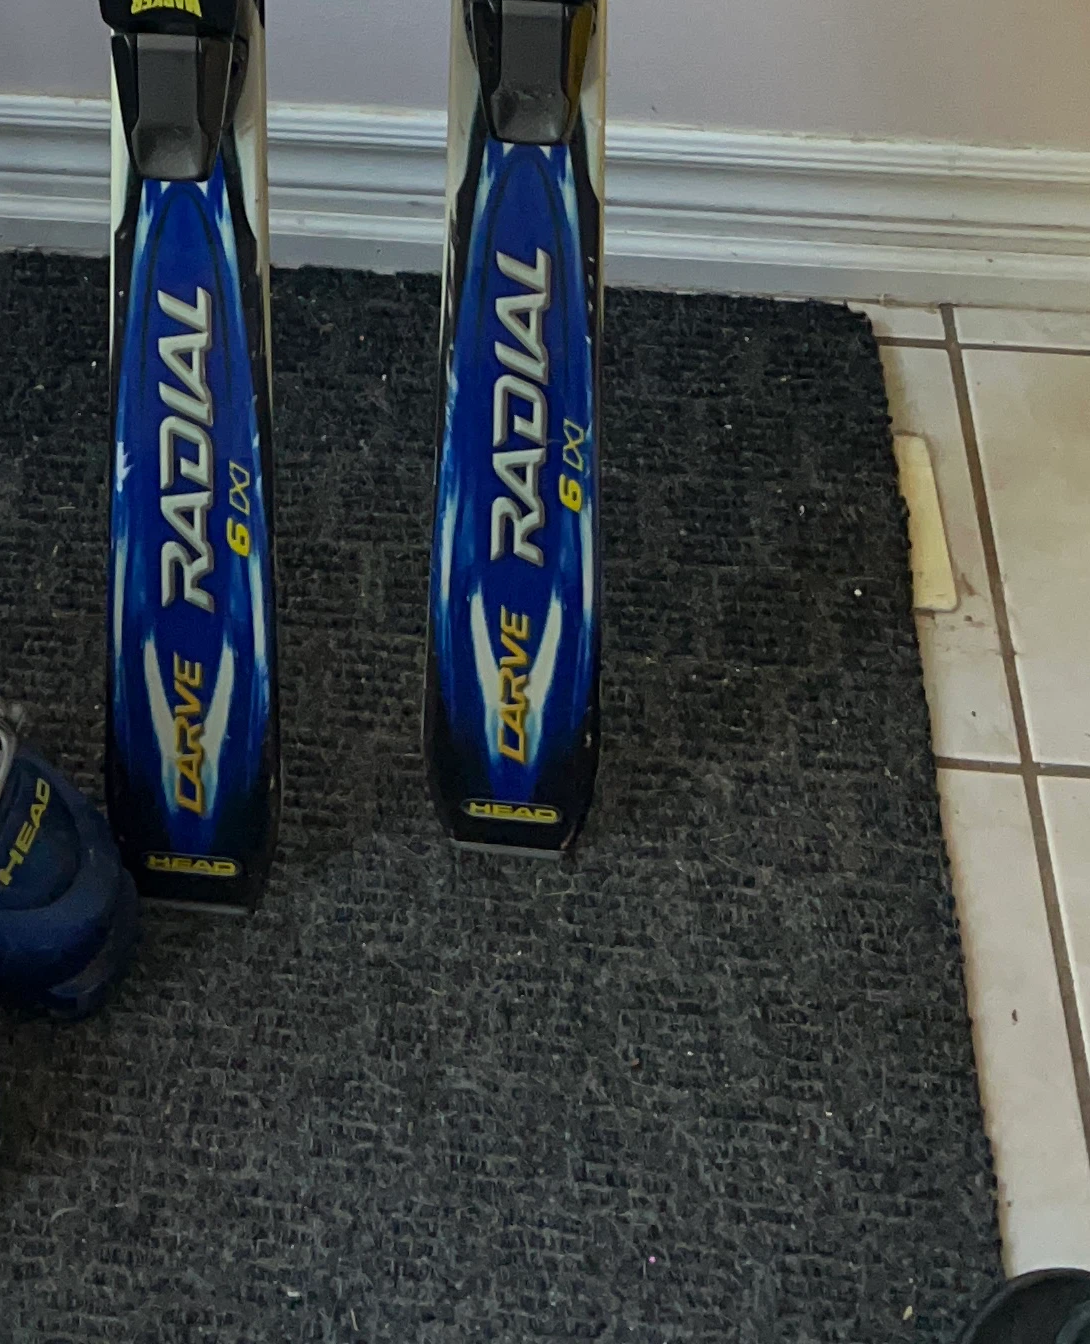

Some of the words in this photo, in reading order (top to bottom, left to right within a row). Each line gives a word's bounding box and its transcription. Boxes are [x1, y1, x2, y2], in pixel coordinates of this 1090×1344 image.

[157, 285, 214, 613] RADIAL
[491, 247, 552, 568] RADIAL
[227, 517, 251, 558] 6
[559, 474, 583, 513] 6
[497, 605, 529, 763] CARVE
[174, 653, 205, 815] CARVE
[468, 801, 557, 823] HEAD
[148, 855, 236, 876] HEAD
